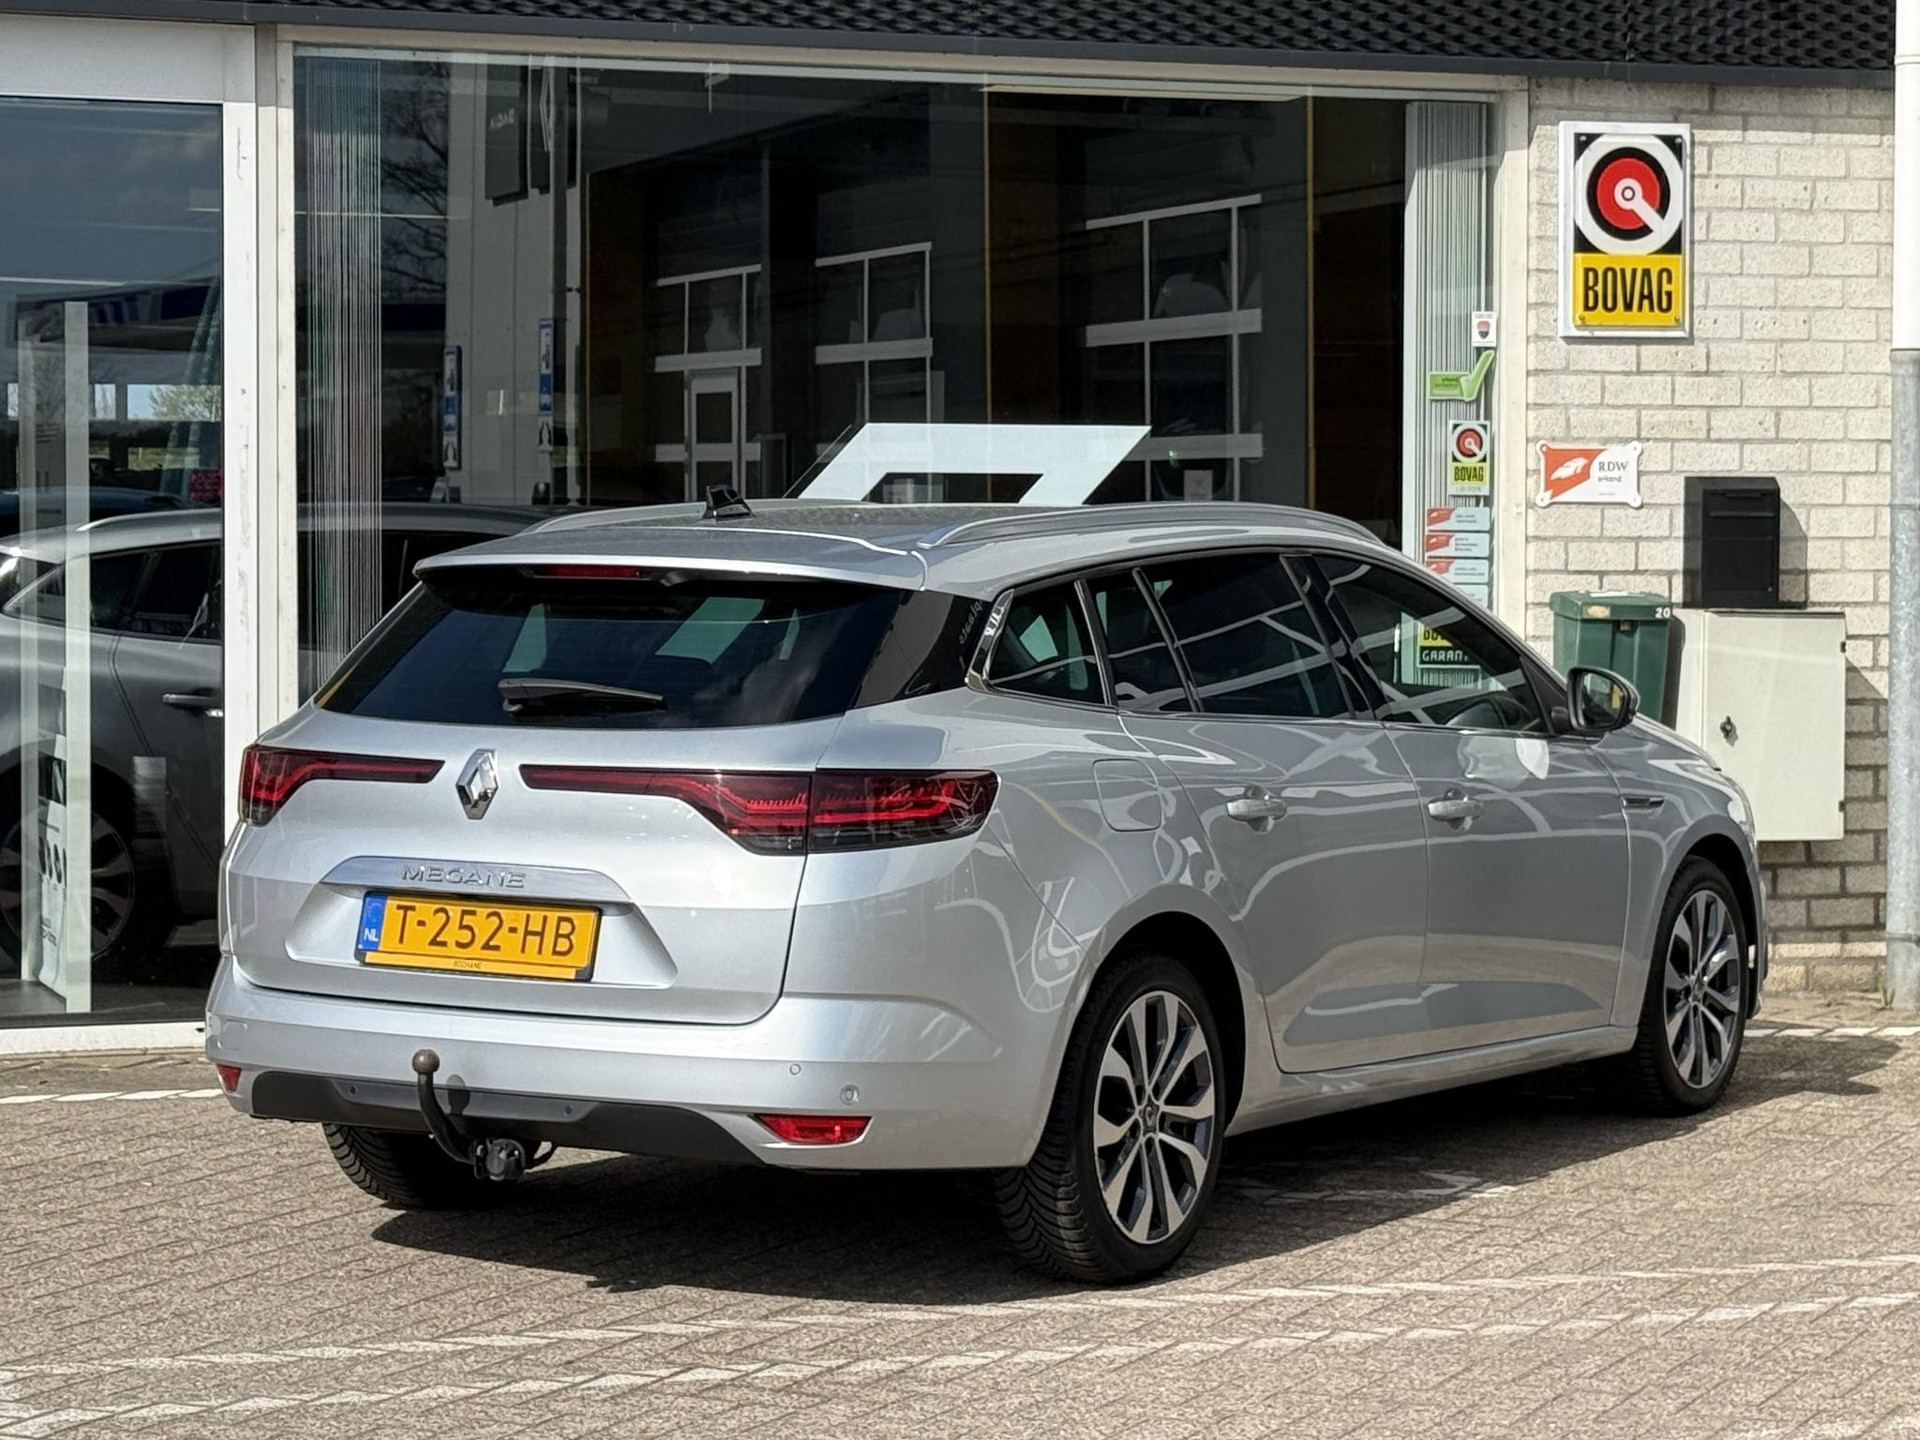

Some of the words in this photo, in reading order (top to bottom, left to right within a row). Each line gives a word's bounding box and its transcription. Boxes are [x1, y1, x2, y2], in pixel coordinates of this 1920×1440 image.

[1583, 266, 1673, 313] BOVAG
[1454, 466, 1484, 481] BOVAG
[1598, 461, 1629, 472] RDW
[1655, 607, 1671, 619] 20
[401, 864, 526, 889] MEGANE
[363, 927, 379, 942] NL
[396, 904, 577, 957] T-252-HB
